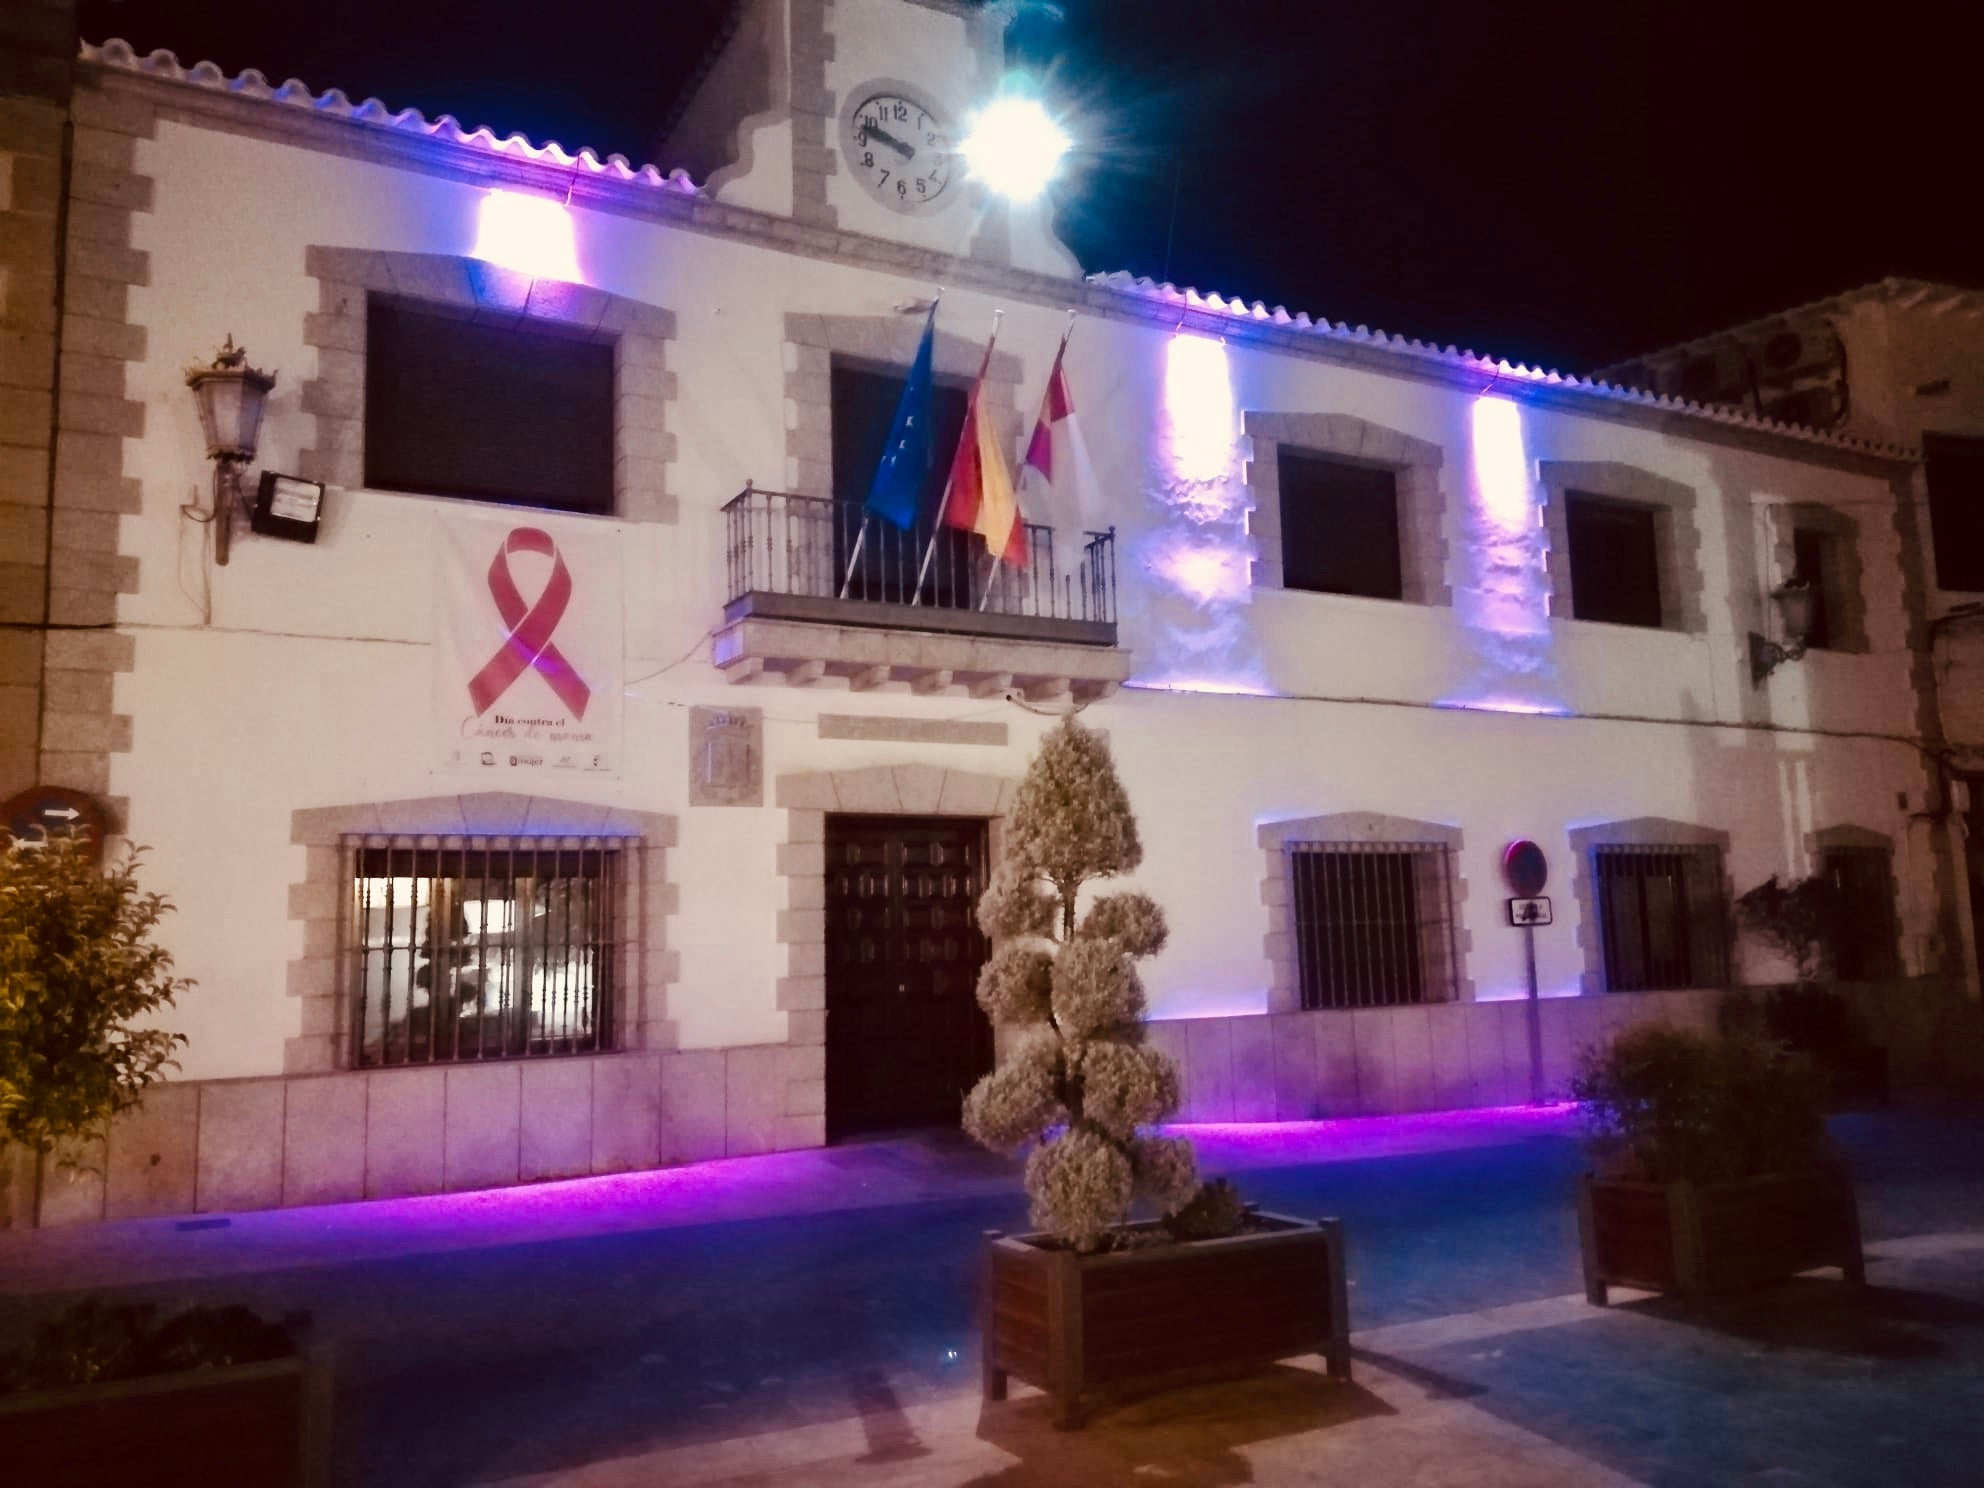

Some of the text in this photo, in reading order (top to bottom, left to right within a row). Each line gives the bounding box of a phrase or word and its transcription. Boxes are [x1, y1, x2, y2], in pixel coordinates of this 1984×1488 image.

[879, 105, 888, 122] 11
[893, 104, 907, 122] 12
[858, 131, 867, 147] 9
[927, 132, 936, 146] 2
[864, 151, 874, 168] 8
[880, 169, 890, 185] 7
[928, 169, 937, 183] 4
[897, 180, 906, 195] 6
[916, 178, 926, 194] 5
